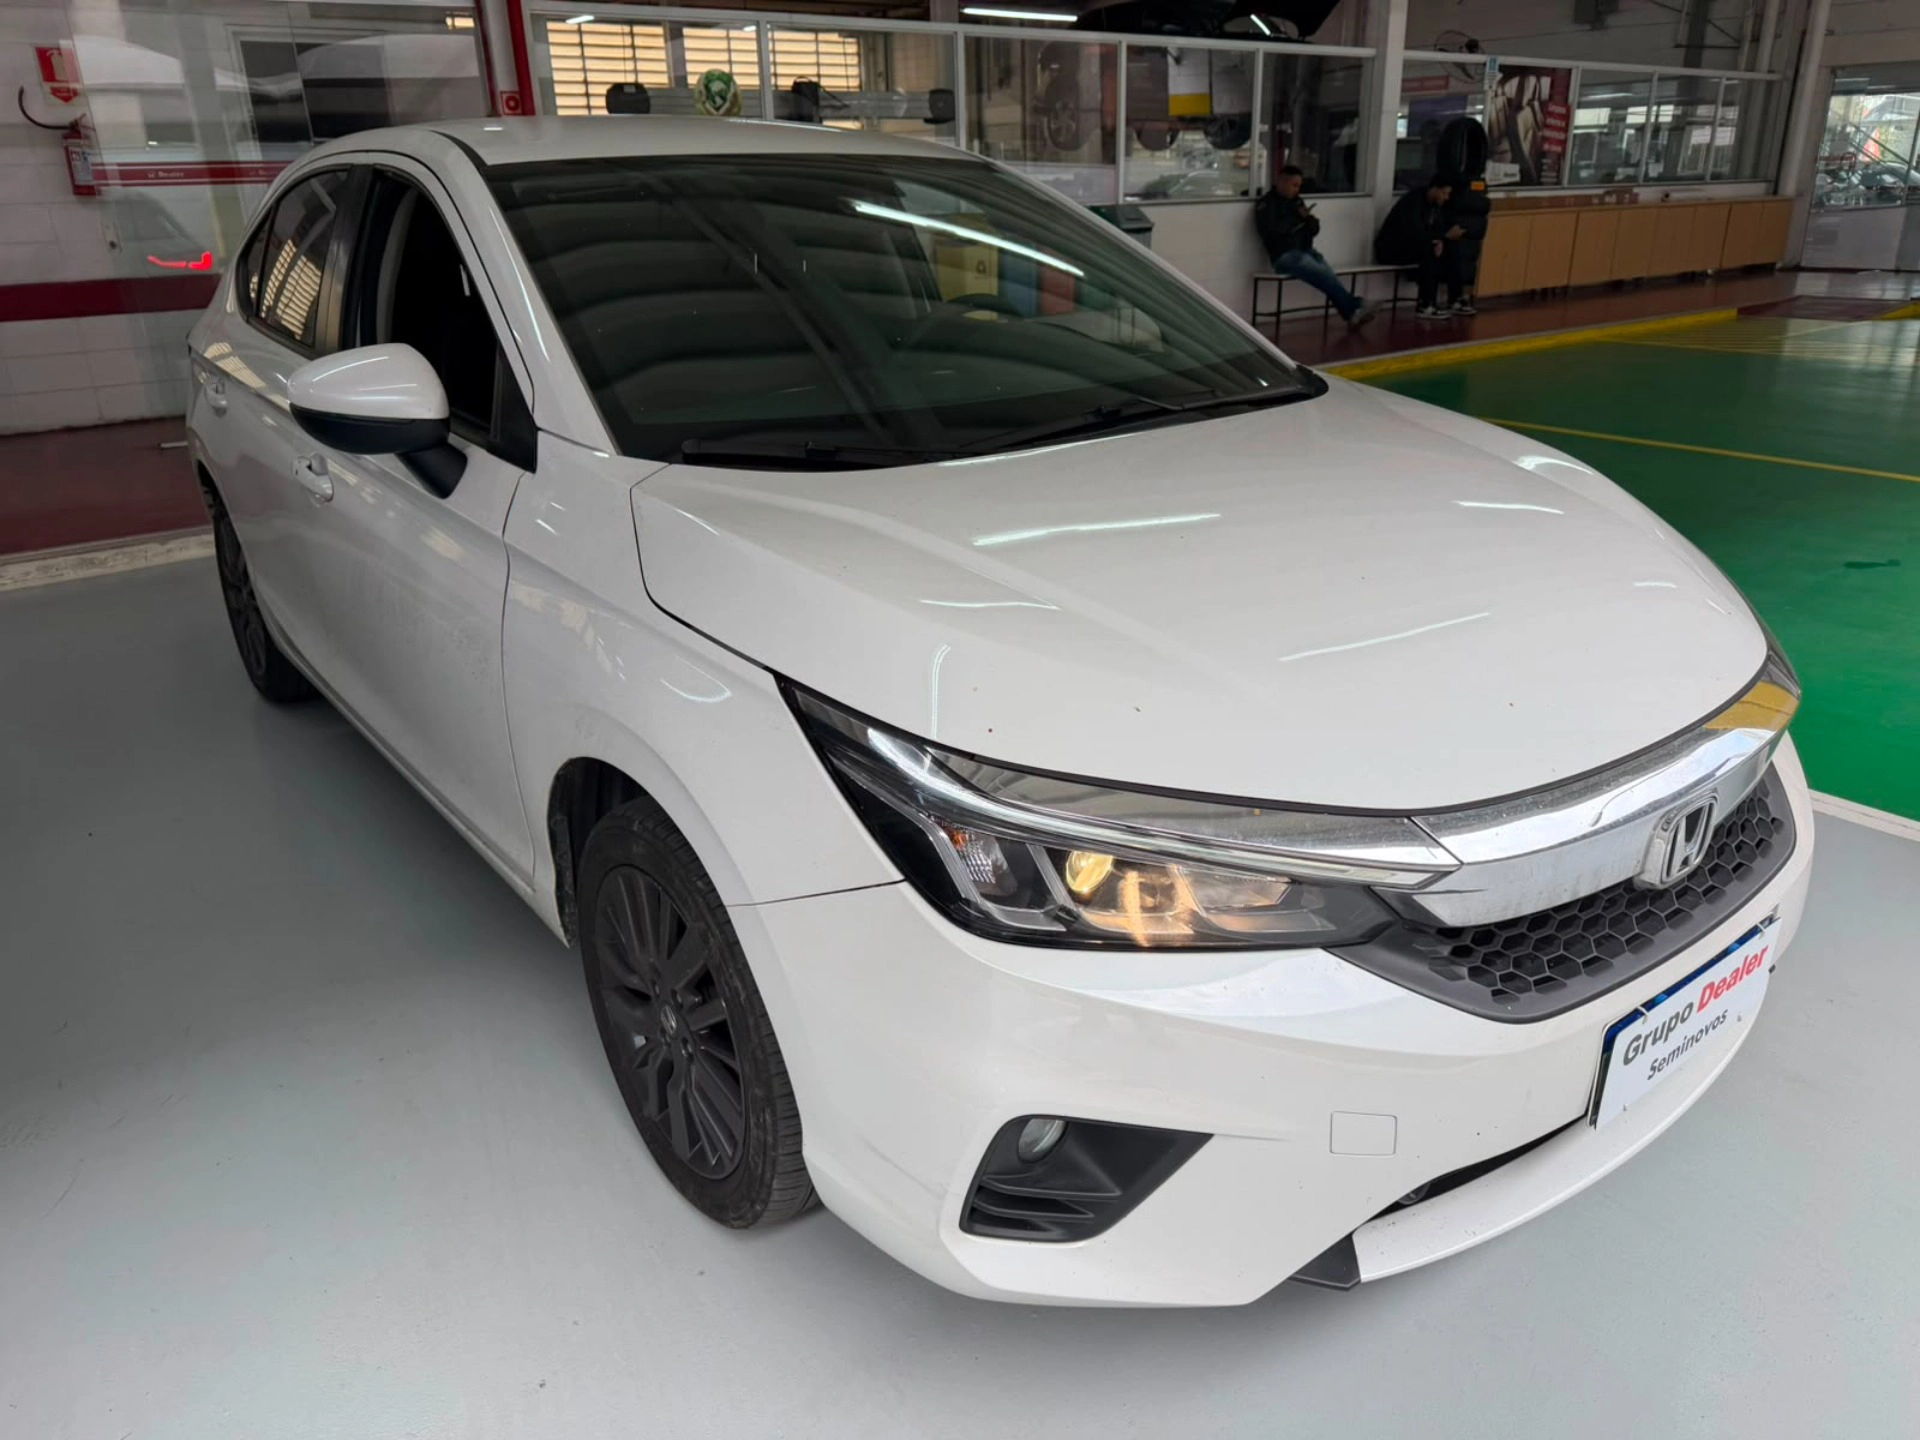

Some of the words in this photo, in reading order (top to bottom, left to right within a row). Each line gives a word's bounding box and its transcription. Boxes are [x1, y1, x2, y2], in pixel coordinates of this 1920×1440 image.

[1623, 1001, 1694, 1066] Grupo
[1696, 945, 1769, 1014] Dealer
[1647, 1009, 1728, 1081] Seminovos
